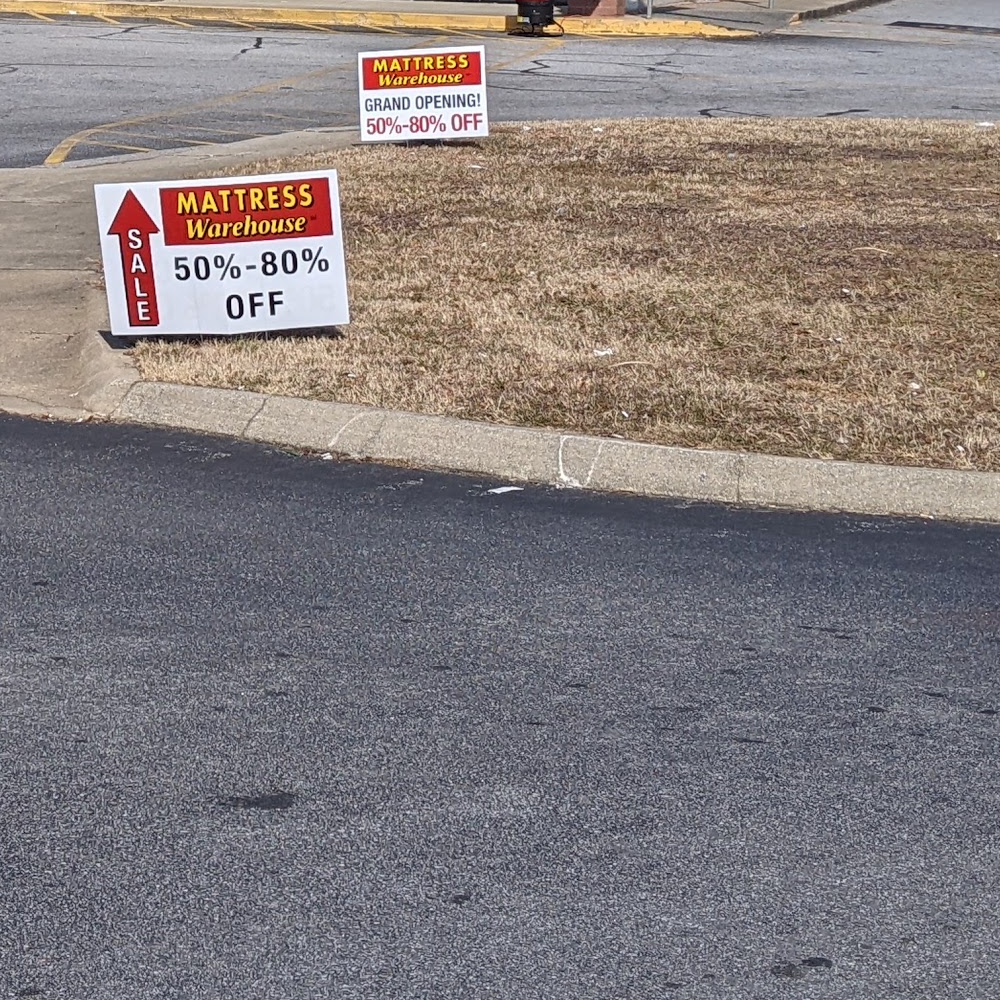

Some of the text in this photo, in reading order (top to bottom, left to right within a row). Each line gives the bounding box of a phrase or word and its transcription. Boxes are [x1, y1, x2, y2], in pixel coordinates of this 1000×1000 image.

[373, 54, 470, 73] MATTRESS
[378, 72, 463, 87] Warehouse
[365, 93, 481, 112] GRAND OPENING!
[366, 113, 483, 135] 50%-80% OFF
[177, 183, 314, 215] MATTRESS
[186, 215, 306, 240] Warehouse
[128, 228, 151, 322] SALE
[174, 247, 330, 281] 50%-80%
[226, 290, 284, 320] OFF
